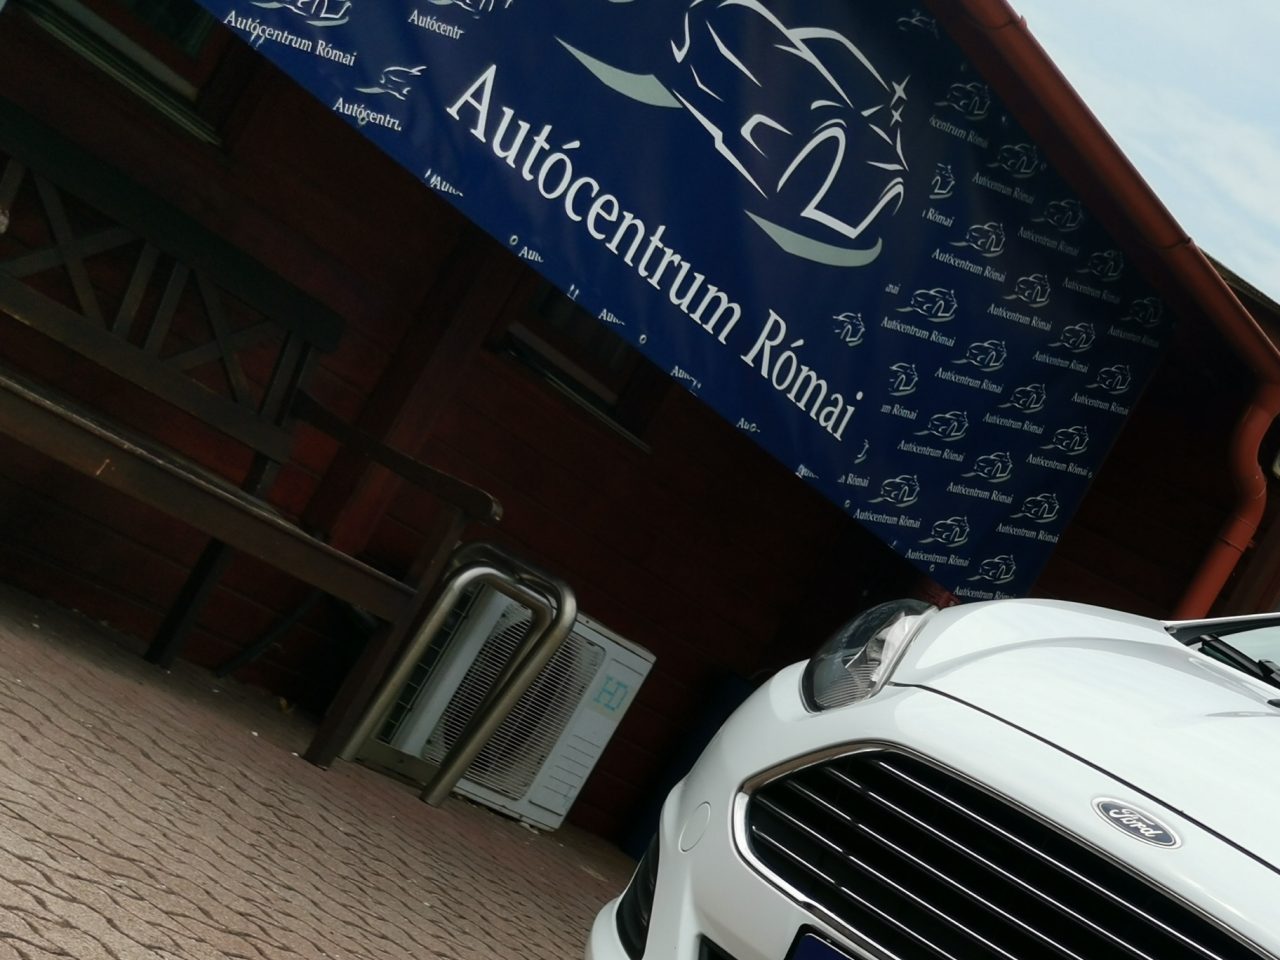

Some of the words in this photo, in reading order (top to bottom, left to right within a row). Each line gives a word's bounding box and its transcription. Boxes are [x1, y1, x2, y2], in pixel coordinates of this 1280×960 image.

[224, 10, 313, 53] Autócentrum
[315, 39, 358, 67] Római
[446, 64, 742, 346] Autócentrum
[740, 308, 864, 442] Római
[929, 330, 957, 347] Római
[1109, 808, 1163, 837] Ford
